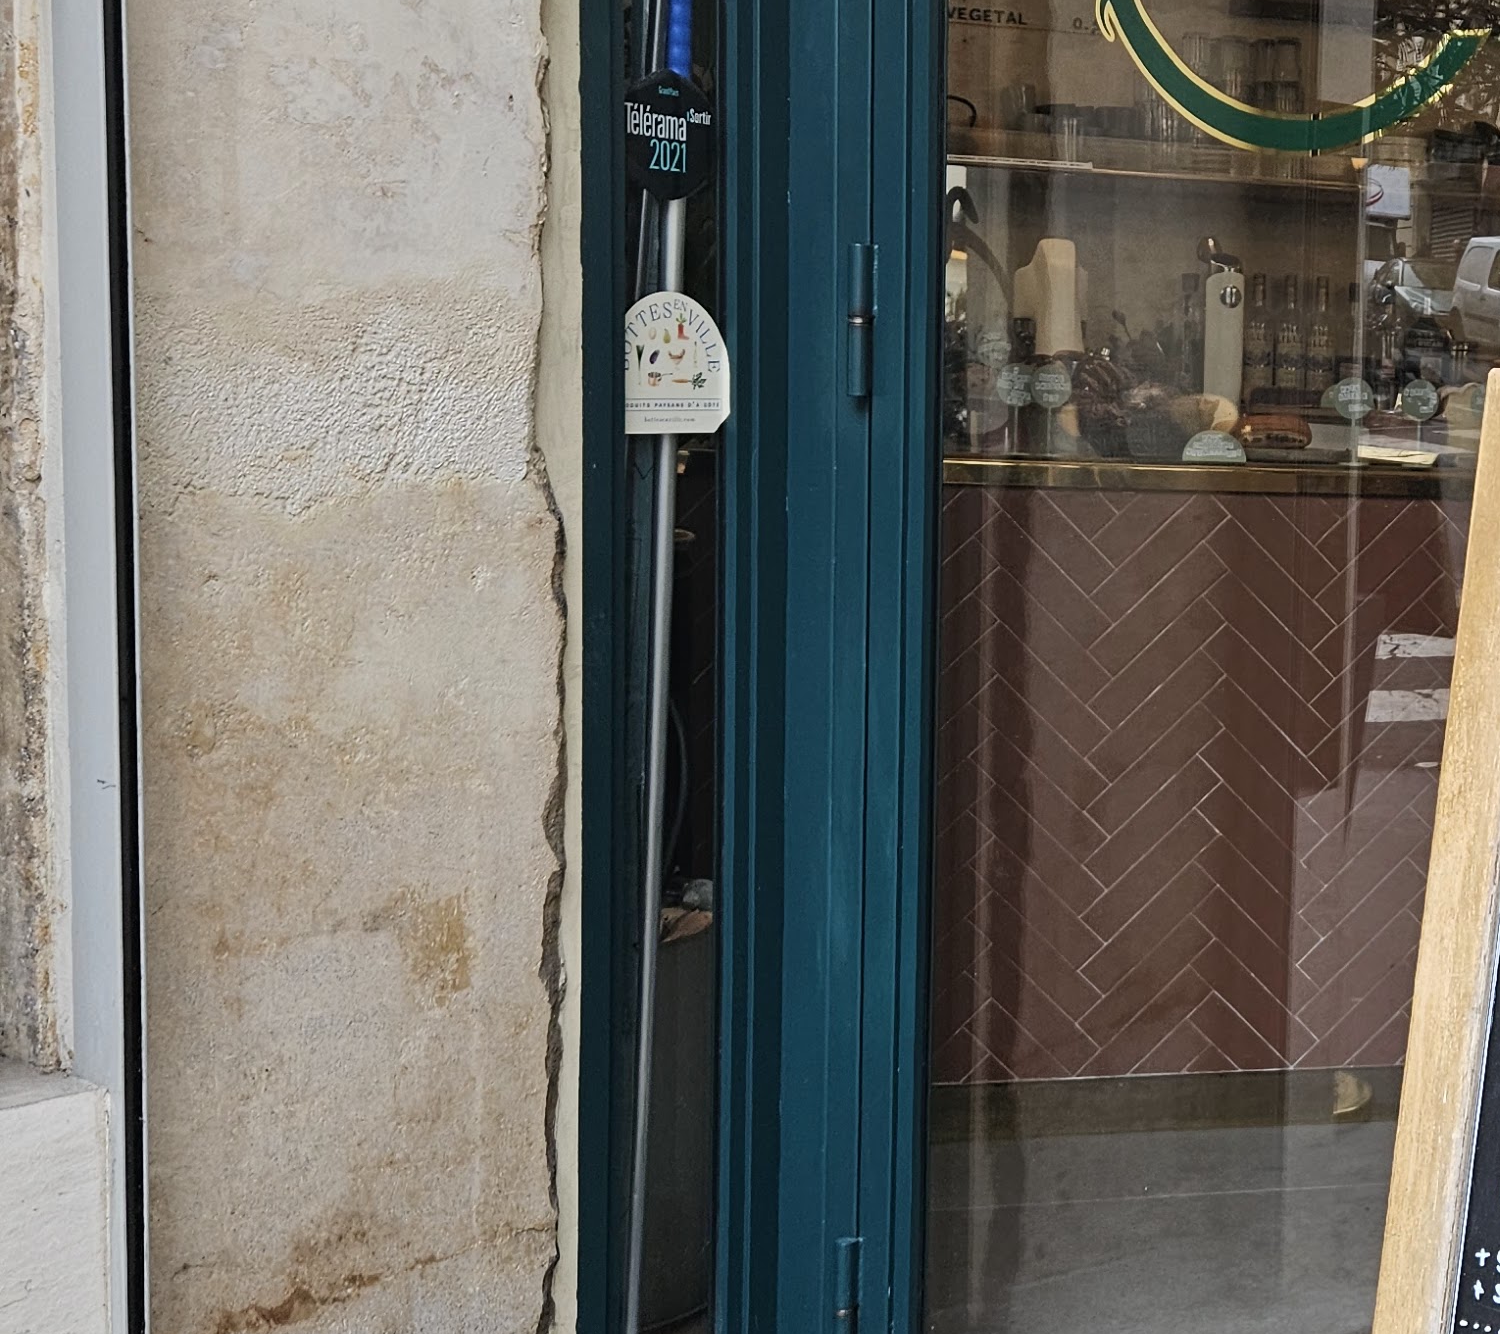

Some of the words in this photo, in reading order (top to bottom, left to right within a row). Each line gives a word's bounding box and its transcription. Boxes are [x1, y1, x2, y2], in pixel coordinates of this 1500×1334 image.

[624, 101, 687, 141] Télérama
[649, 139, 687, 173] 2021
[687, 308, 721, 373] VILLE
